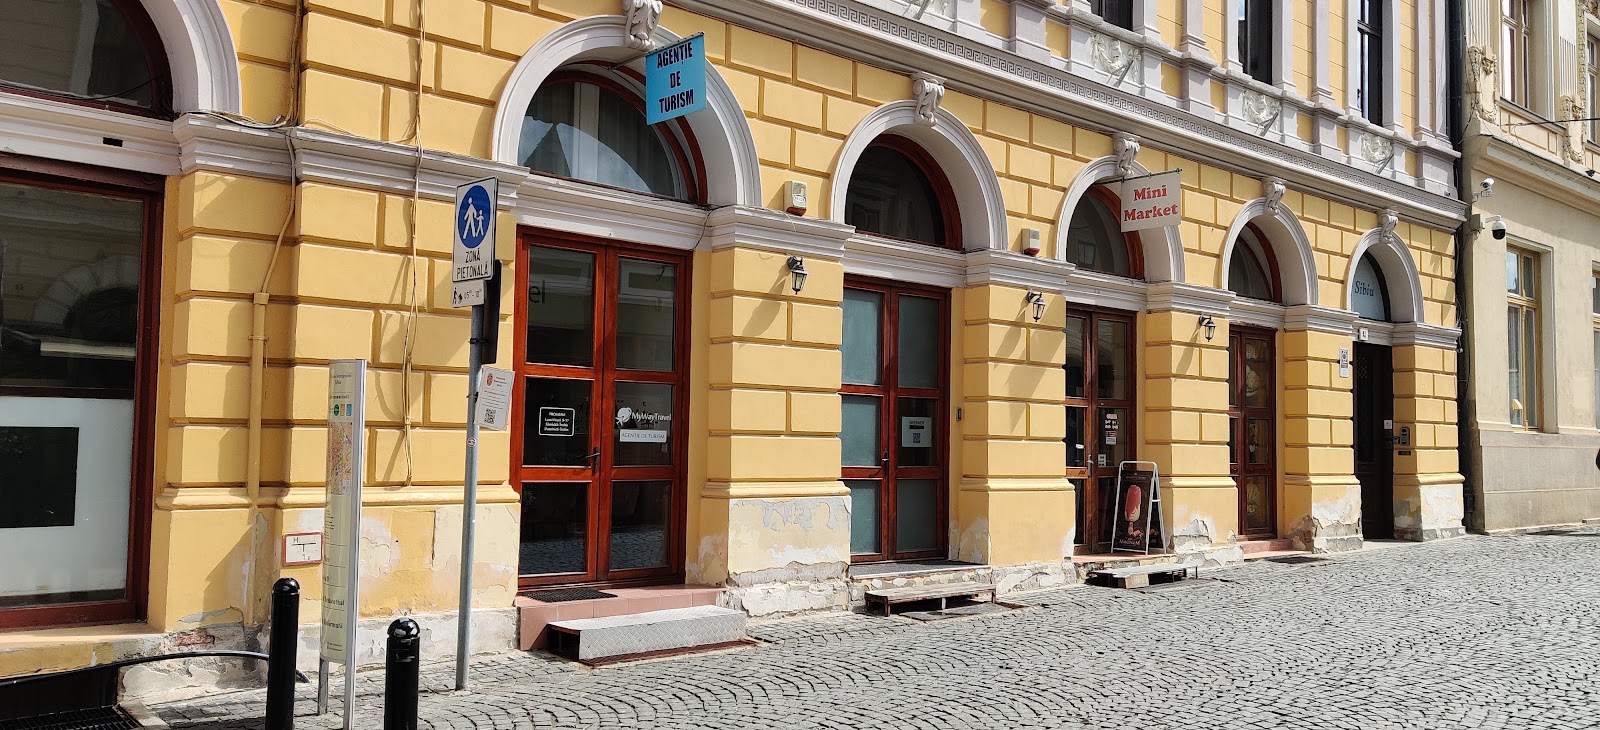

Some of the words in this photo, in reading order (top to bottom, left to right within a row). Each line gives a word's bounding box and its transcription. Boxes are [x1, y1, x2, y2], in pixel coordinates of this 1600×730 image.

[657, 42, 693, 69] AGENȚIE
[669, 71, 681, 89] DE
[659, 89, 694, 113] TURISM
[1133, 184, 1168, 201] Mini
[1123, 204, 1179, 222] Market
[1354, 280, 1375, 297] Sibiu
[631, 412, 672, 422] MyWayTravel
